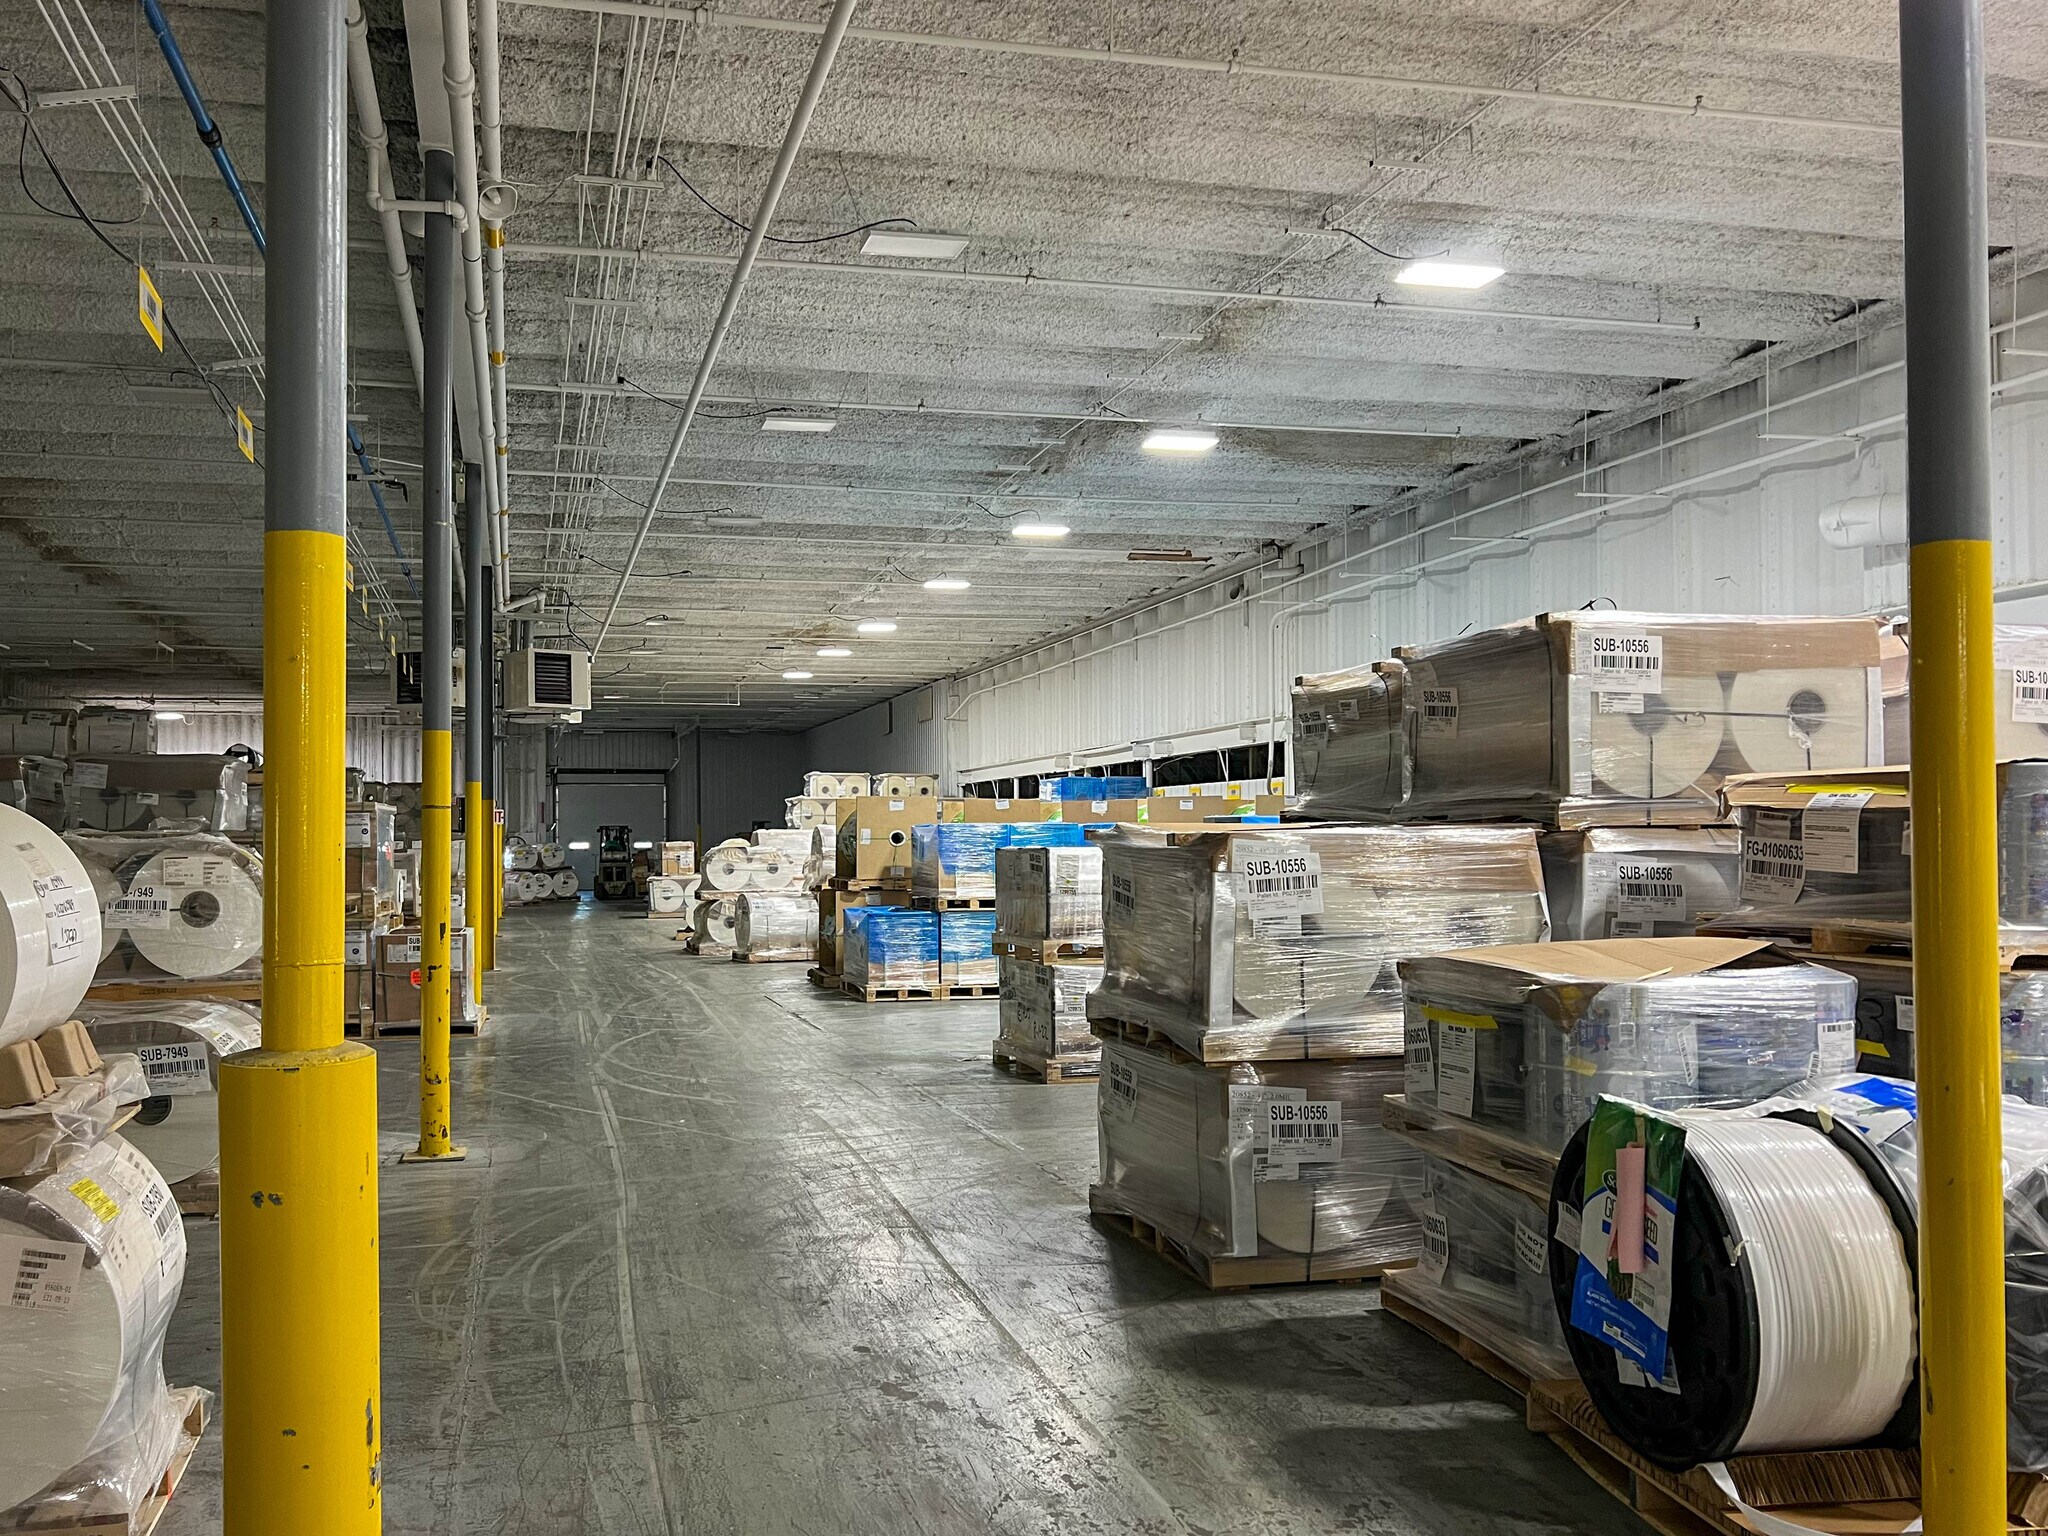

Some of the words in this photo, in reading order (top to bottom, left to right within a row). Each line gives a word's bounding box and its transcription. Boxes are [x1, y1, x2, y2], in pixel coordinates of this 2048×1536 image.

[1594, 637, 1649, 653] SUB-10556
[1746, 840, 1804, 861] FG-01060633
[1247, 858, 1307, 876] SUB-10556
[1620, 866, 1673, 881] SUB-10556
[125, 887, 154, 898] -7949
[140, 1045, 189, 1062] SUB-7949
[1270, 1105, 1328, 1121] SUB-10556
[1527, 1233, 1545, 1249] NOT
